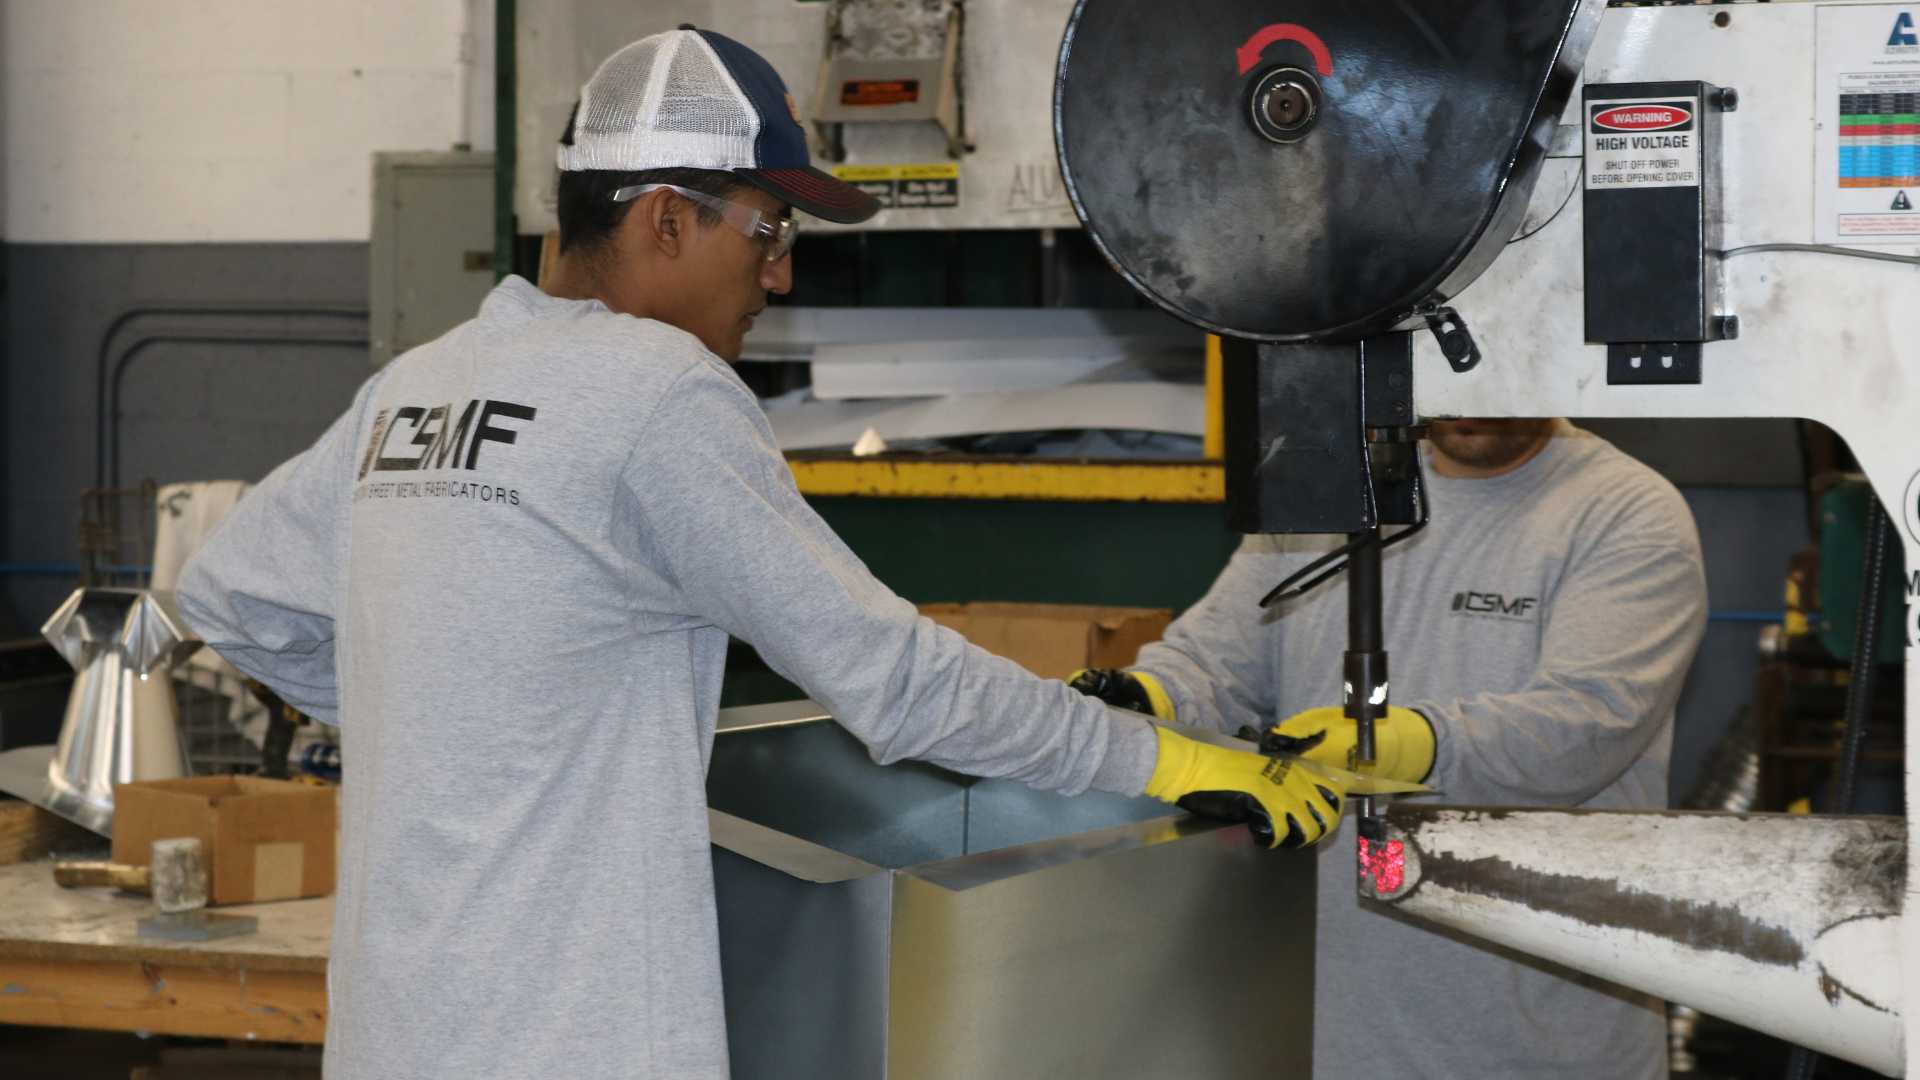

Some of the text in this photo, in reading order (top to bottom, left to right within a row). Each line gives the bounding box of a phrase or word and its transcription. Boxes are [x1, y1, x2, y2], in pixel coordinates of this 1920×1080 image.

[1612, 112, 1673, 124] WARNING
[1595, 135, 1690, 150] HIGH VOLTAGE
[1605, 159, 1680, 170] SHUT OFF POWER
[1592, 171, 1695, 184] BEFORE OPENING COVER
[374, 399, 538, 471] CSMF
[425, 481, 521, 506] FABRICATORS
[1466, 591, 1537, 616] CSMF
